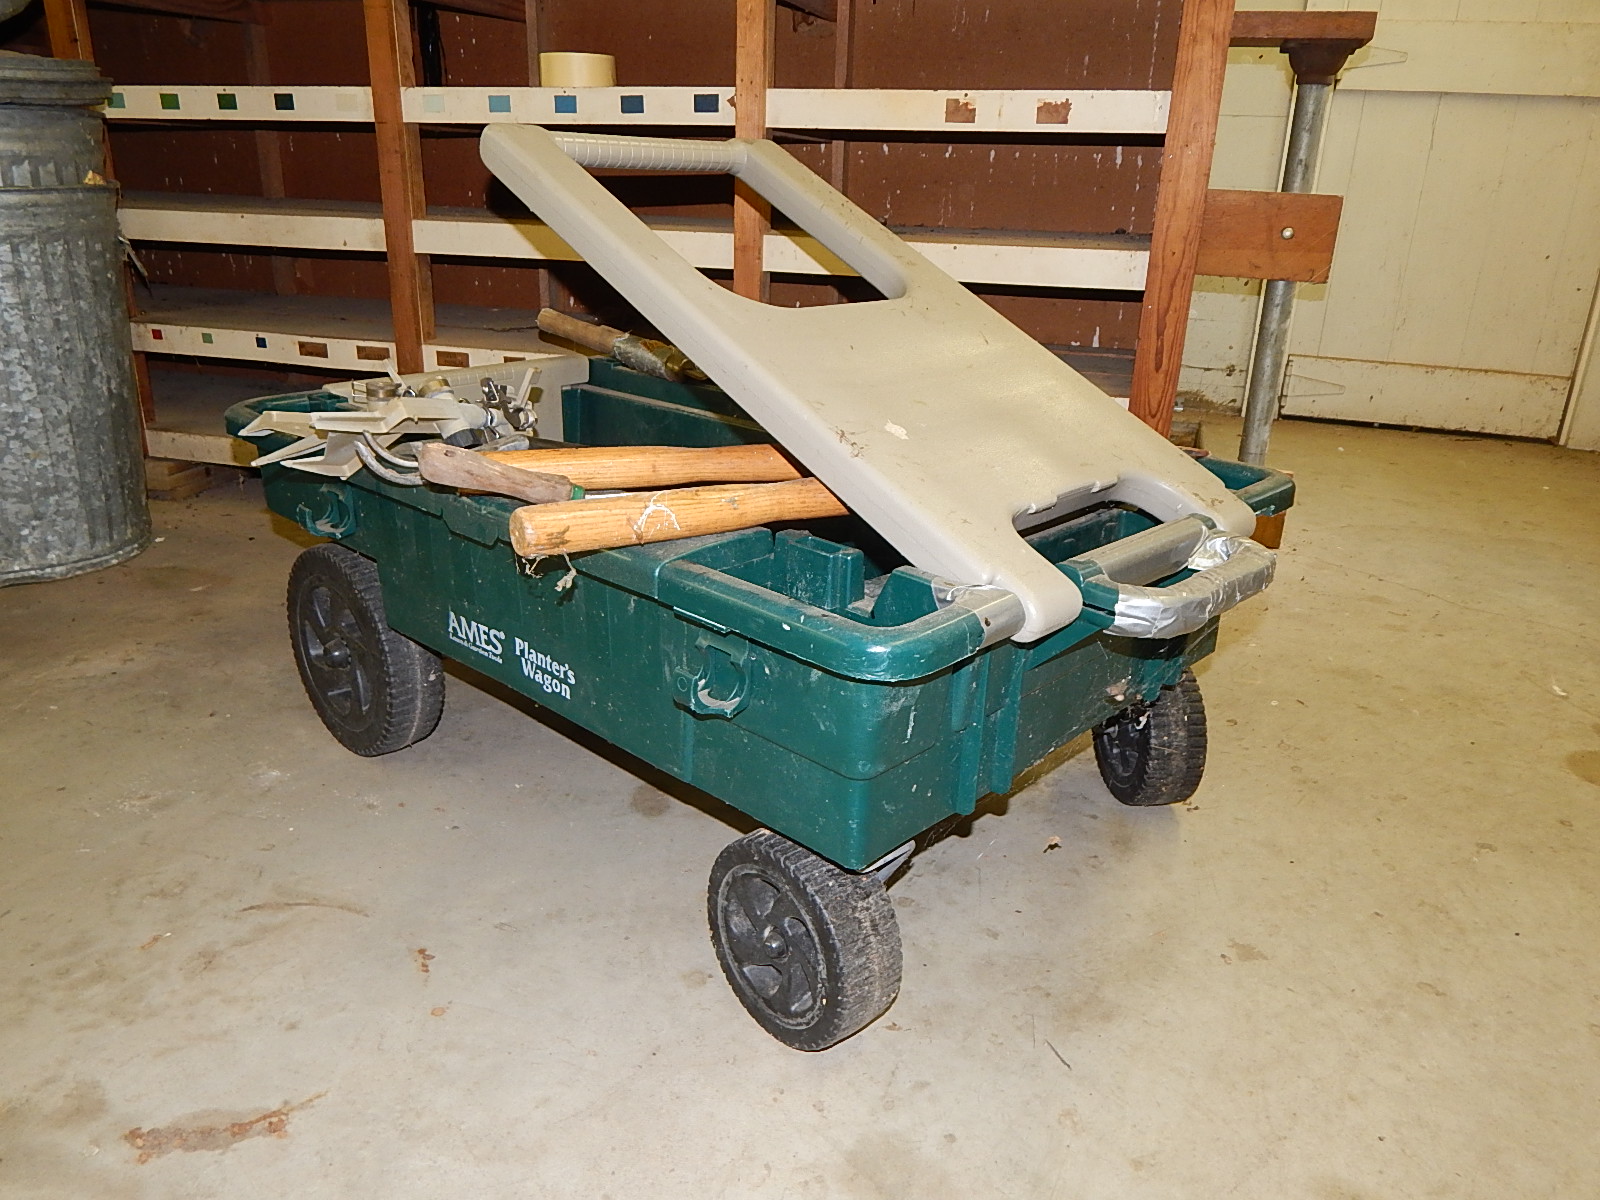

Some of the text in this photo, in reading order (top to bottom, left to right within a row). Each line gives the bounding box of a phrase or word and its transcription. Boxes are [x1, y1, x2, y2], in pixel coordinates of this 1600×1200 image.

[448, 611, 503, 655] AMES
[514, 637, 576, 685] Planter's
[521, 657, 571, 700] Wagon
